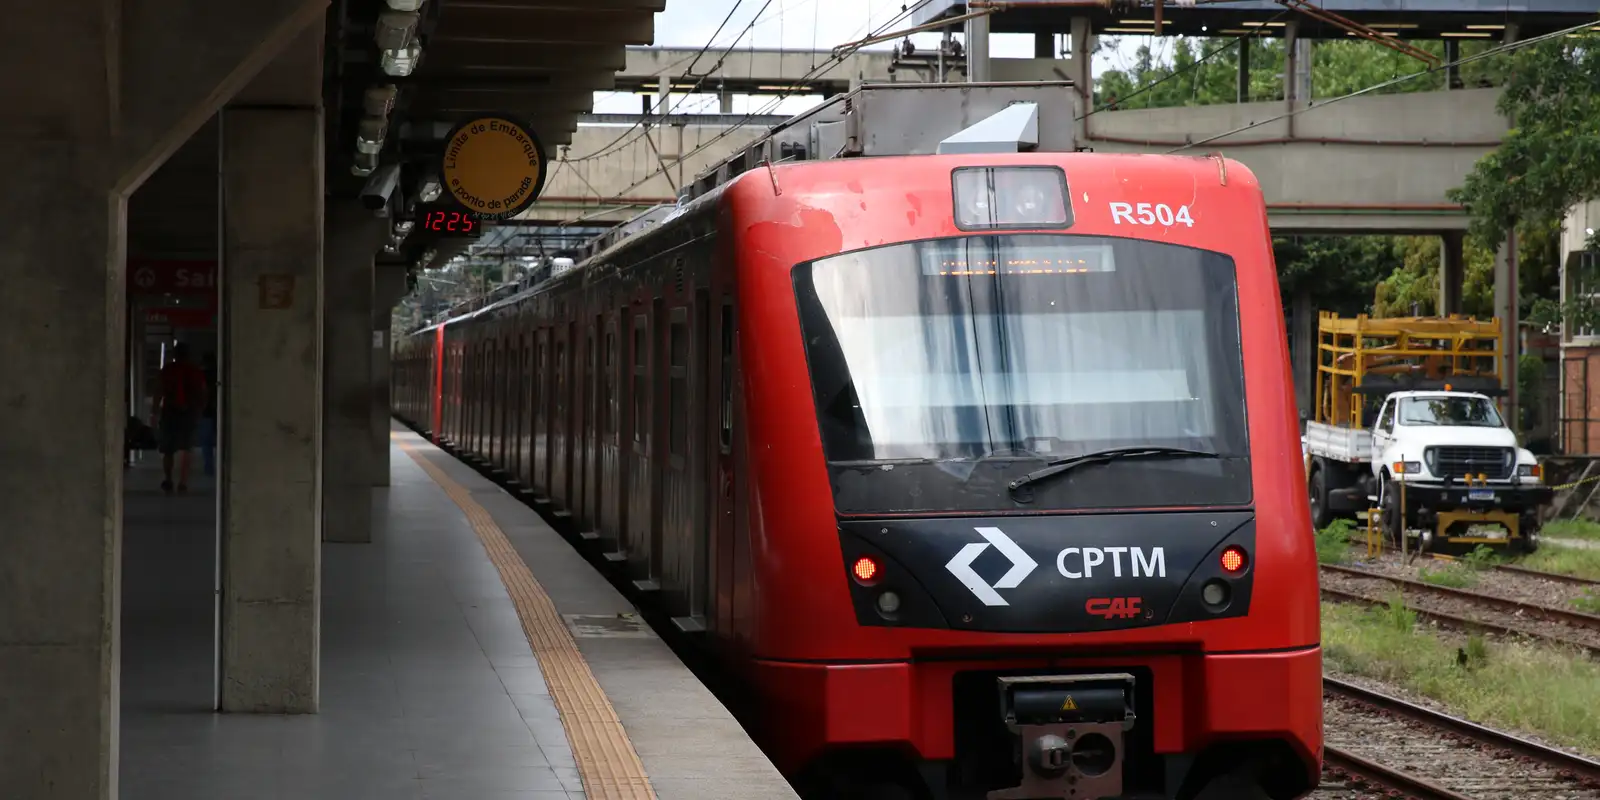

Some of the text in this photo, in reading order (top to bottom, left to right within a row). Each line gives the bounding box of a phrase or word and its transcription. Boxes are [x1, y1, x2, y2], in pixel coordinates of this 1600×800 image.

[446, 121, 537, 169] Limite de Embarque
[451, 176, 532, 209] e ponto de parada
[1109, 202, 1195, 227] R504
[1056, 546, 1166, 579] CPTM
[1085, 597, 1142, 619] CAF
